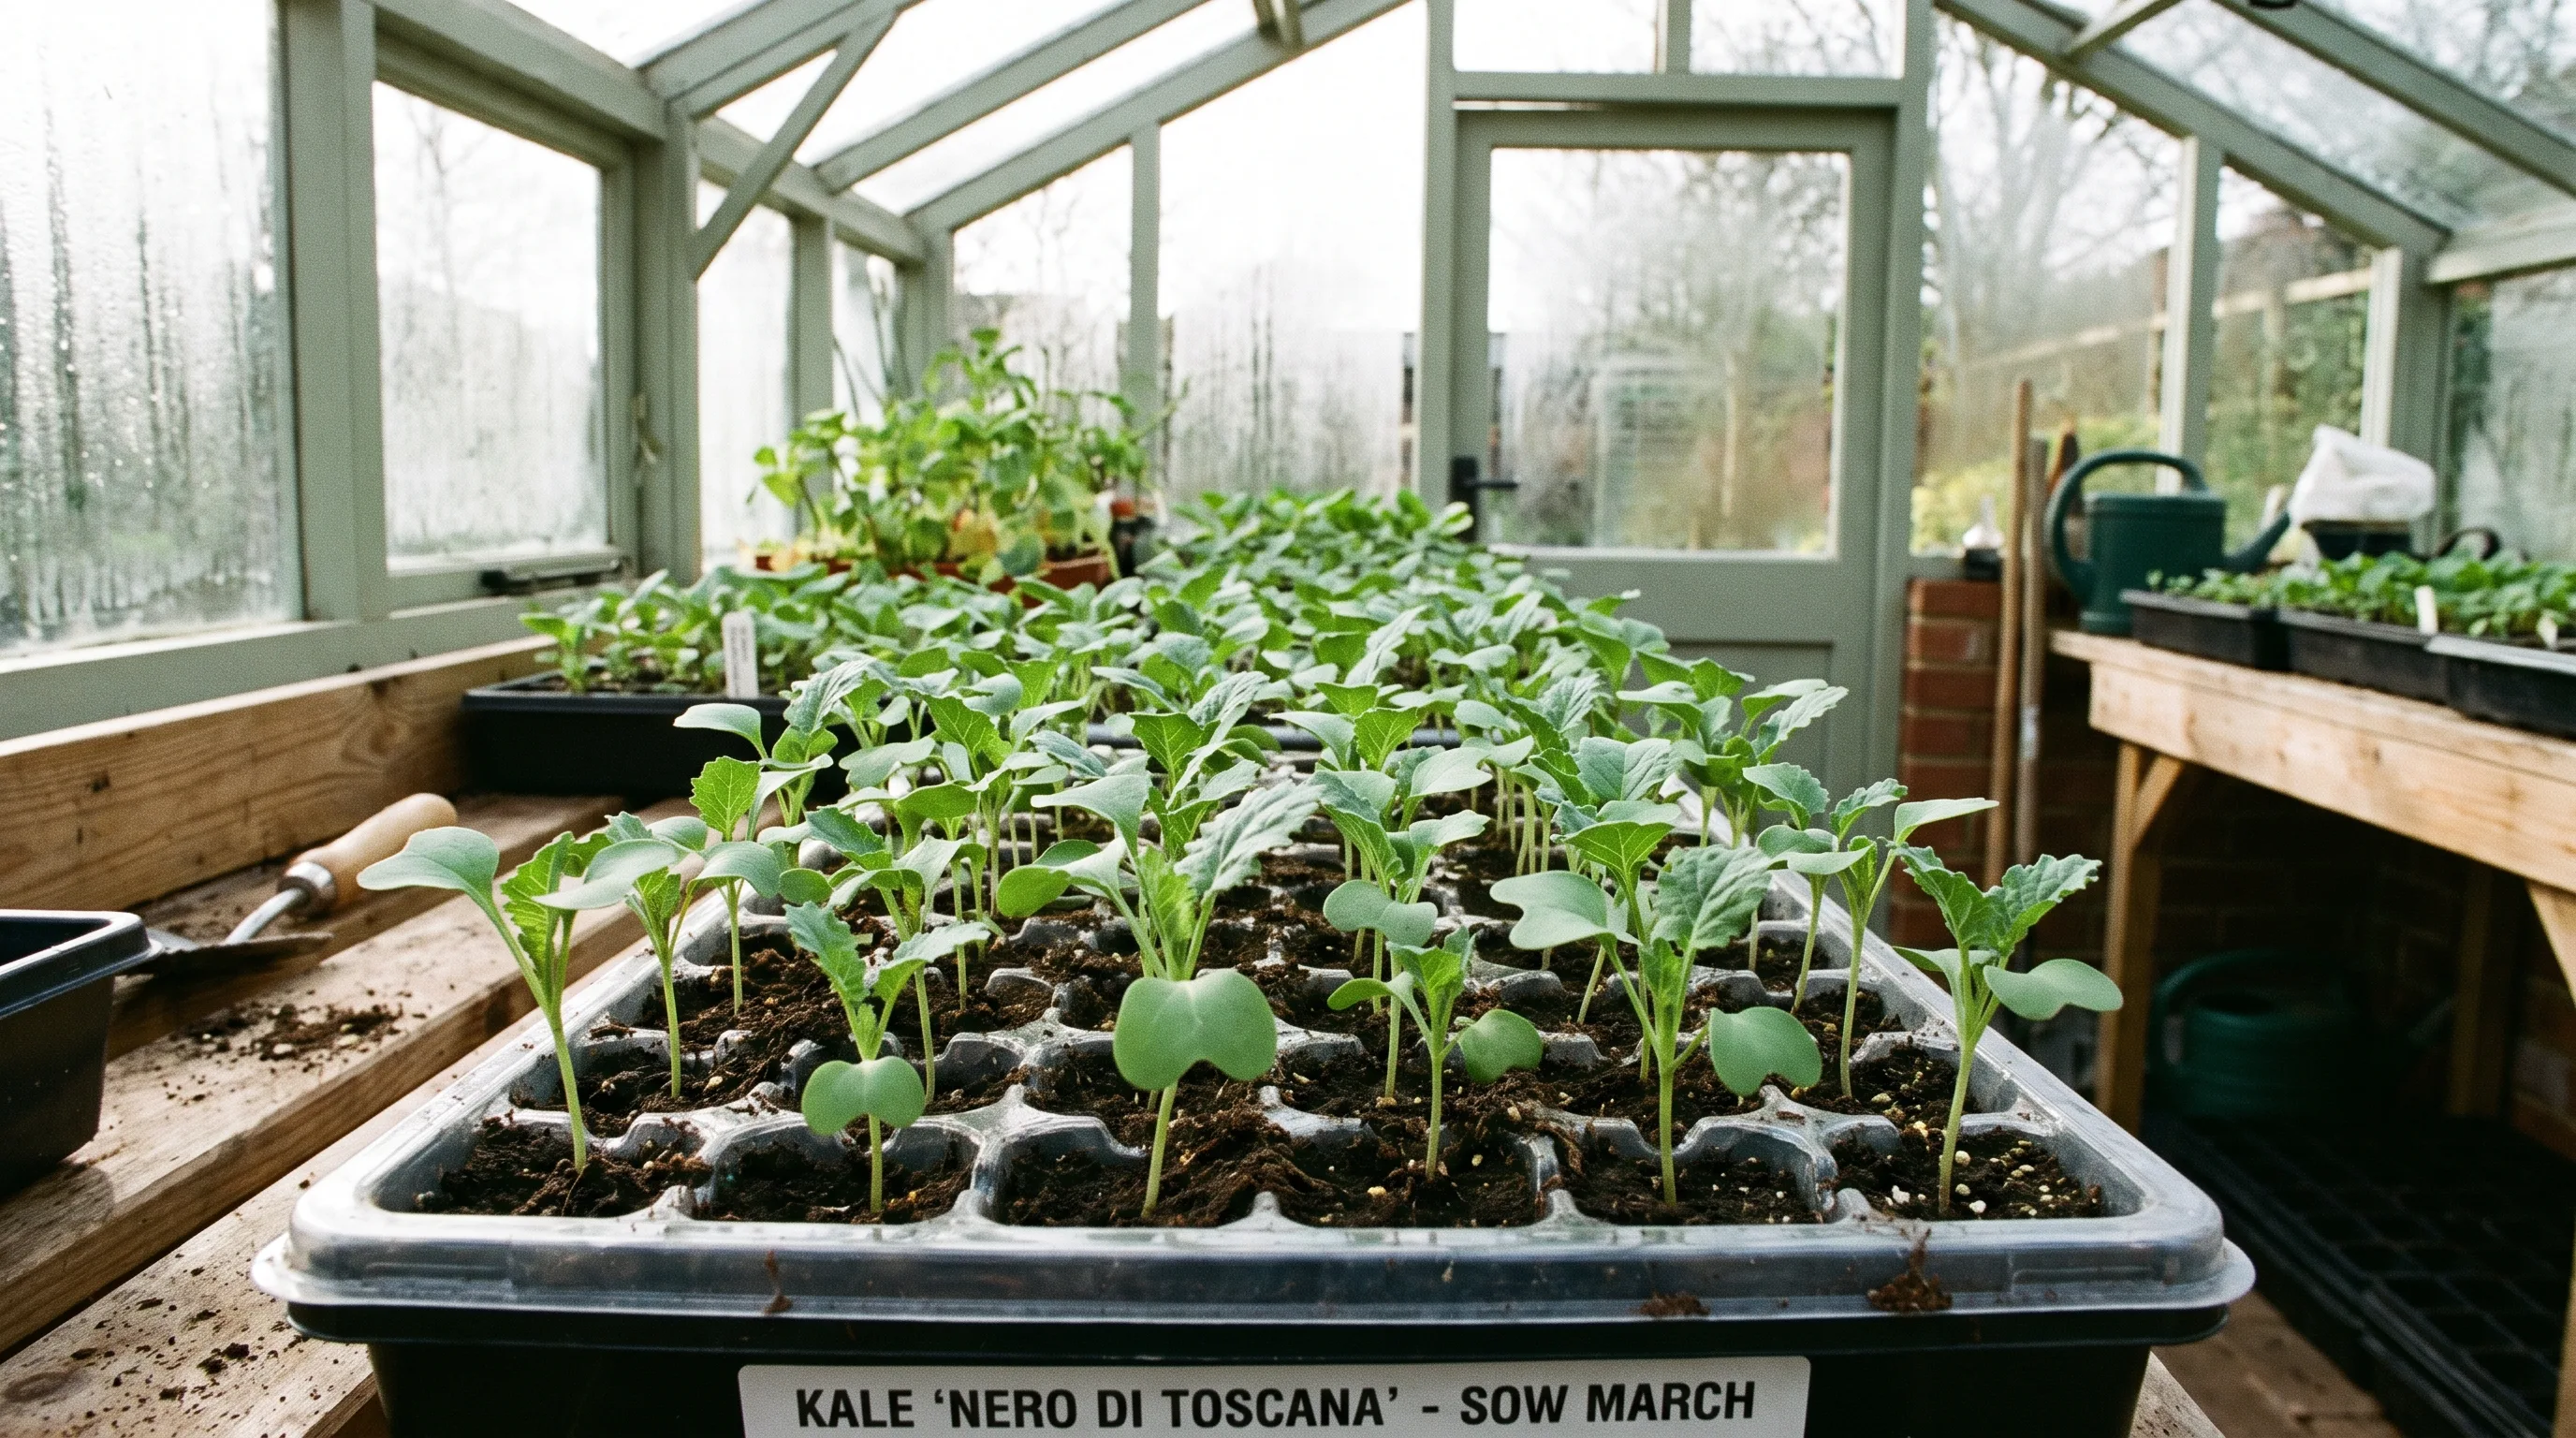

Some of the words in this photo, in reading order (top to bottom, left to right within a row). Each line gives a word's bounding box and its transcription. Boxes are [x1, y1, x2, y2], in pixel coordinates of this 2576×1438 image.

[796, 1388, 915, 1429] KALE
[1096, 1388, 1143, 1429] DI
[1421, 1405, 1440, 1414] -
[1459, 1384, 1570, 1426] SOW
[1586, 1380, 1756, 1423] MARCH
